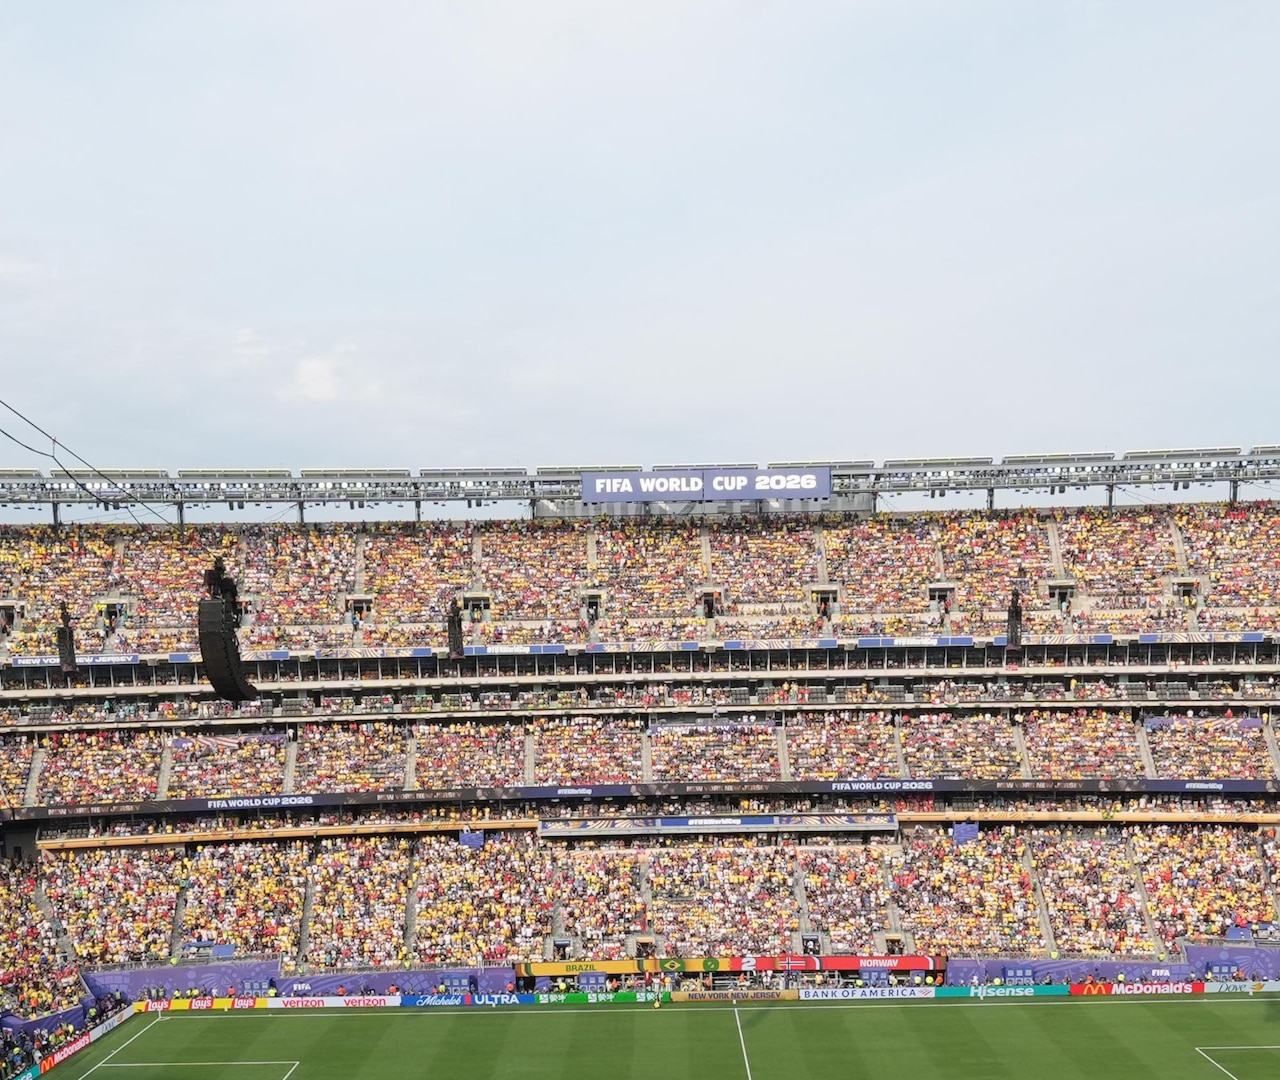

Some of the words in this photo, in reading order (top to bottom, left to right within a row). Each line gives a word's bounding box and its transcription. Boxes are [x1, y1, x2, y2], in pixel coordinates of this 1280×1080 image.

[595, 478, 633, 493] FIFA
[639, 477, 702, 492] WORLD
[712, 476, 748, 491] CUP
[755, 474, 817, 489] 2026
[832, 782, 851, 790] FIFA
[851, 782, 883, 790] WORLD
[884, 781, 902, 790] CUP
[902, 781, 933, 790] 2026
[207, 800, 228, 809] FIFA
[228, 798, 260, 807] WORLD
[261, 797, 280, 806] CUP
[281, 796, 313, 805] 2026
[565, 964, 597, 972] BRAZIL
[741, 958, 757, 971] 2
[859, 958, 899, 967] NORWAY
[1151, 968, 1170, 977] FIFA
[293, 982, 312, 991] FIFA
[970, 985, 1035, 997] Hisense
[1111, 982, 1193, 995] McDonald's
[1218, 982, 1247, 993] Dove
[688, 992, 706, 1000] NEW
[804, 989, 839, 998] BANK
[841, 988, 858, 998] OF
[860, 987, 916, 997] AMERICA
[147, 999, 170, 1011] Lay's
[191, 998, 212, 1010] Lay's
[234, 997, 255, 1009] Lay's
[282, 998, 325, 1008] verizon
[343, 997, 387, 1007] verizon
[416, 994, 462, 1006] Michelob
[474, 994, 520, 1005] ULTRA
[53, 1035, 91, 1064] McDonald's
